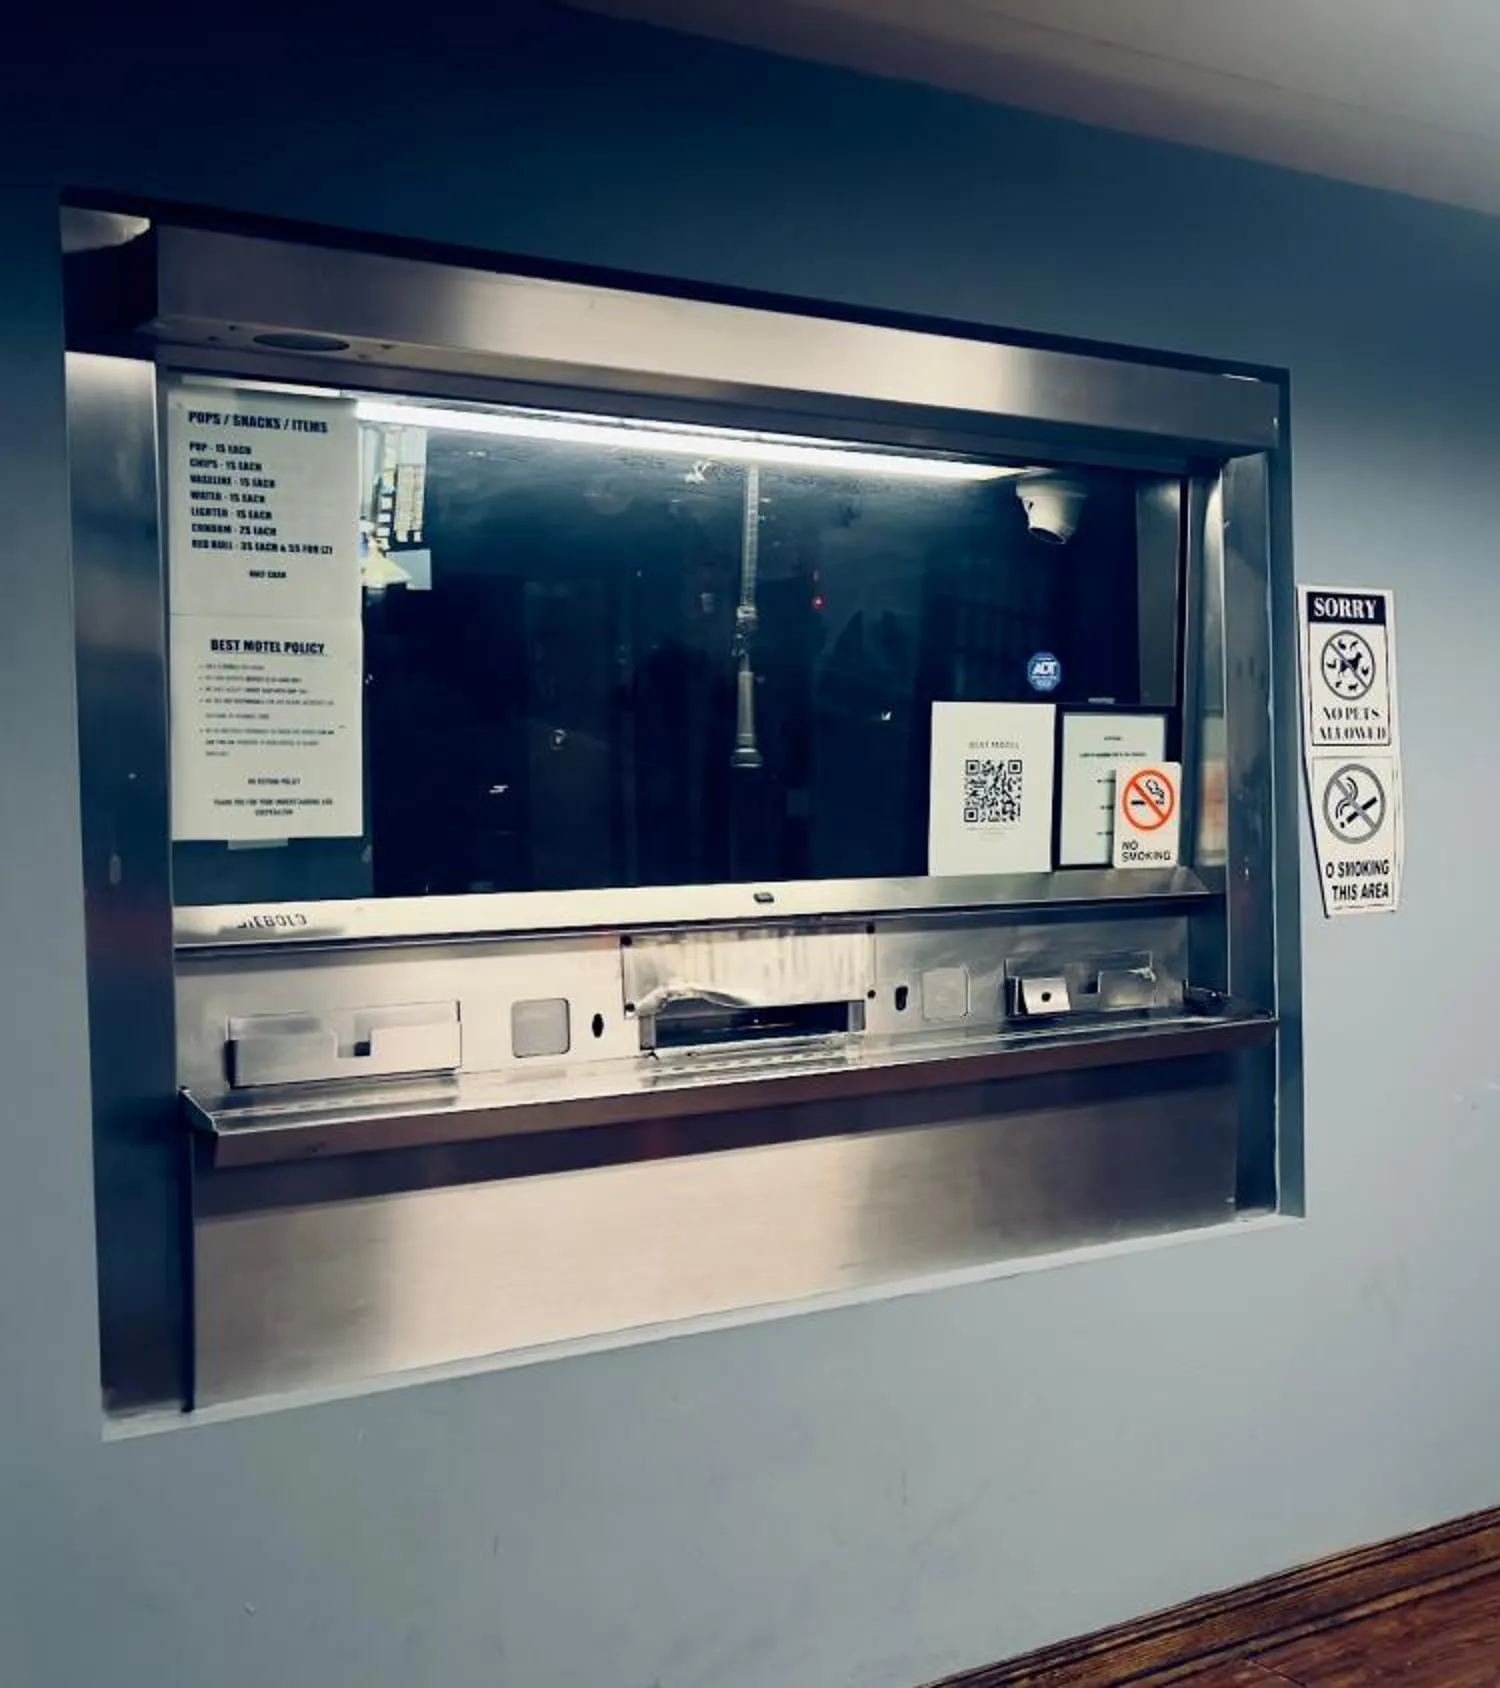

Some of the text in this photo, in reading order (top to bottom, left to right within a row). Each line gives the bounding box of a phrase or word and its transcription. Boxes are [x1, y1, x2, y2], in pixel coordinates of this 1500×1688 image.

[188, 410, 221, 425] POPS
[232, 413, 281, 430] SNACKS
[292, 419, 329, 433] ITEMS
[1313, 597, 1377, 619] SORRY
[210, 638, 325, 655] BEST MOTEL POLICY
[1032, 661, 1057, 675] ADT
[1323, 706, 1380, 721] NO PETS
[1319, 726, 1387, 741] ALLOWED
[1121, 839, 1139, 851] NO
[1121, 851, 1172, 862] SMOKING
[1338, 858, 1390, 879] SMOKING
[1331, 882, 1389, 902] THIS AREA
